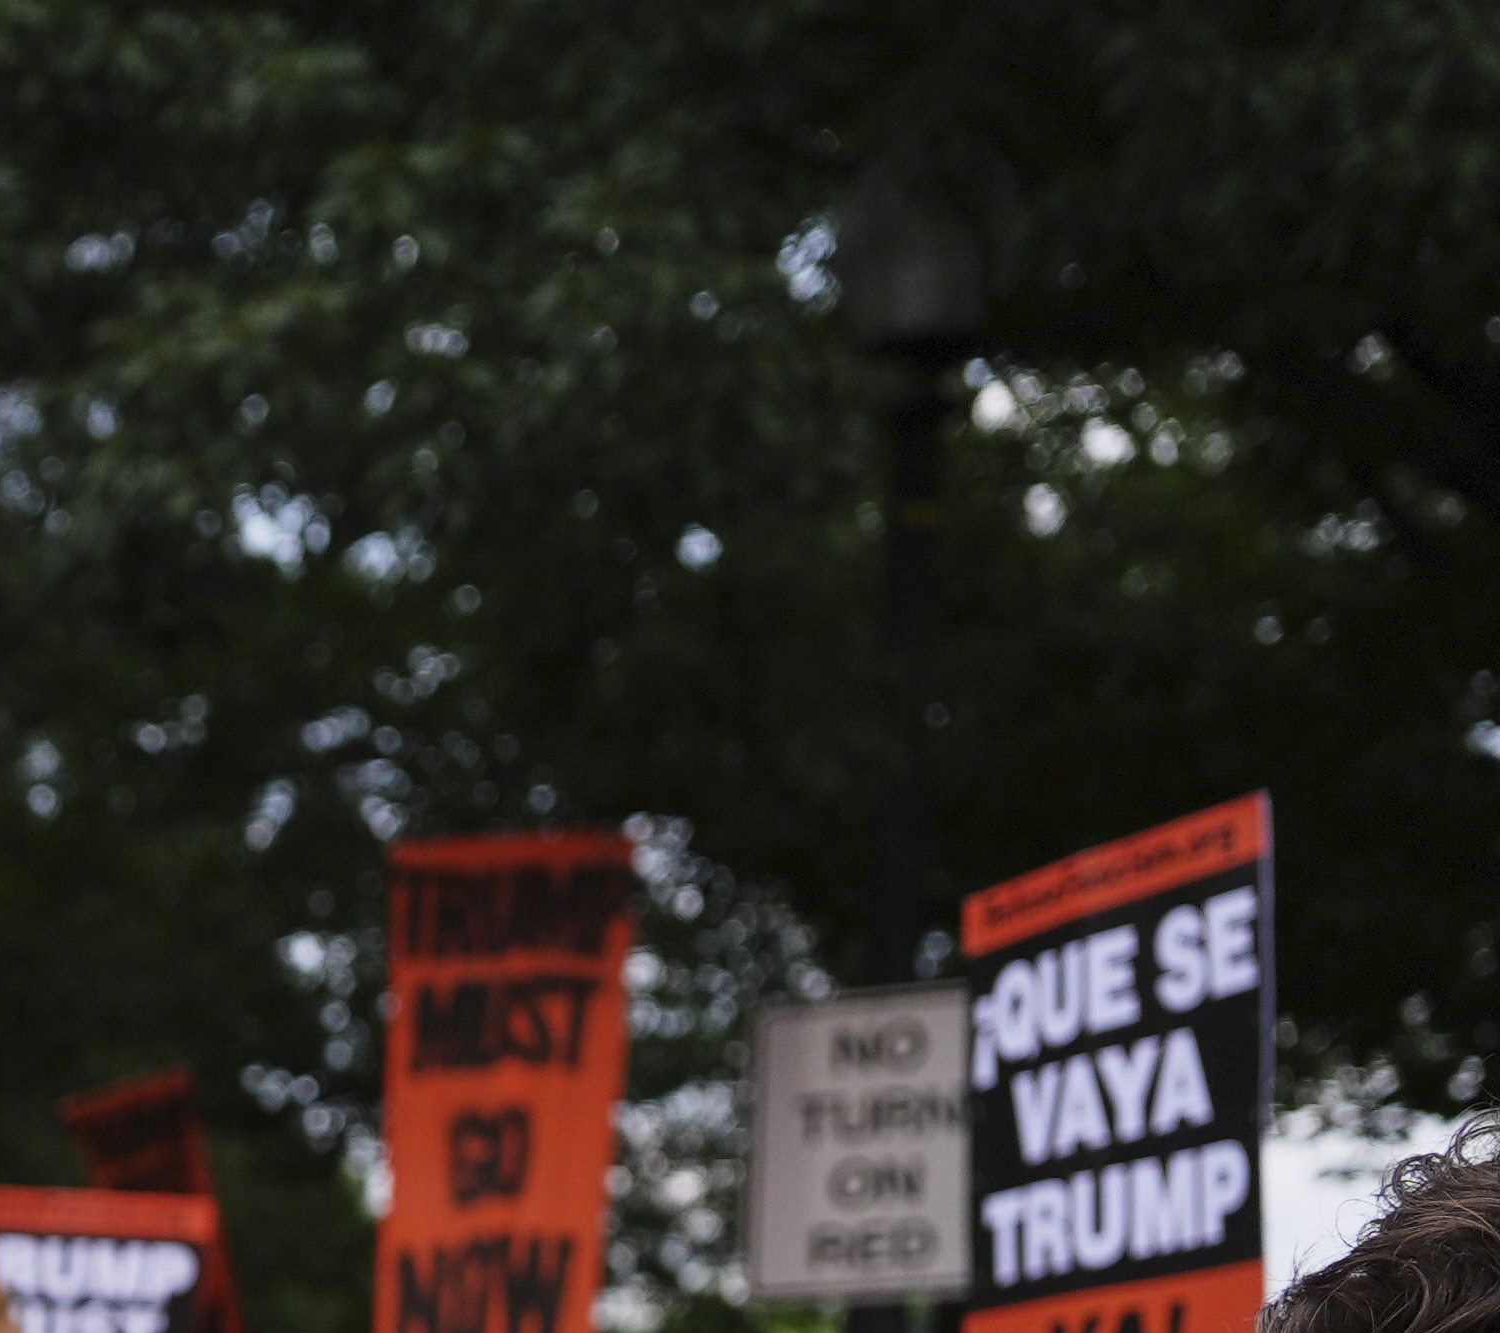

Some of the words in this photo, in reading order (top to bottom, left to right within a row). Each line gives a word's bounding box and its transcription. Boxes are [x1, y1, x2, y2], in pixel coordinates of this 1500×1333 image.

[971, 922, 1143, 1093] ¡QUE
[1153, 884, 1261, 1013] SE
[828, 1014, 933, 1076] NO
[800, 1088, 961, 1147] TURN
[1010, 1025, 1215, 1168] VAYA
[827, 1154, 926, 1210] ON
[806, 1216, 939, 1272] RED
[980, 1137, 1250, 1290] TRUMP
